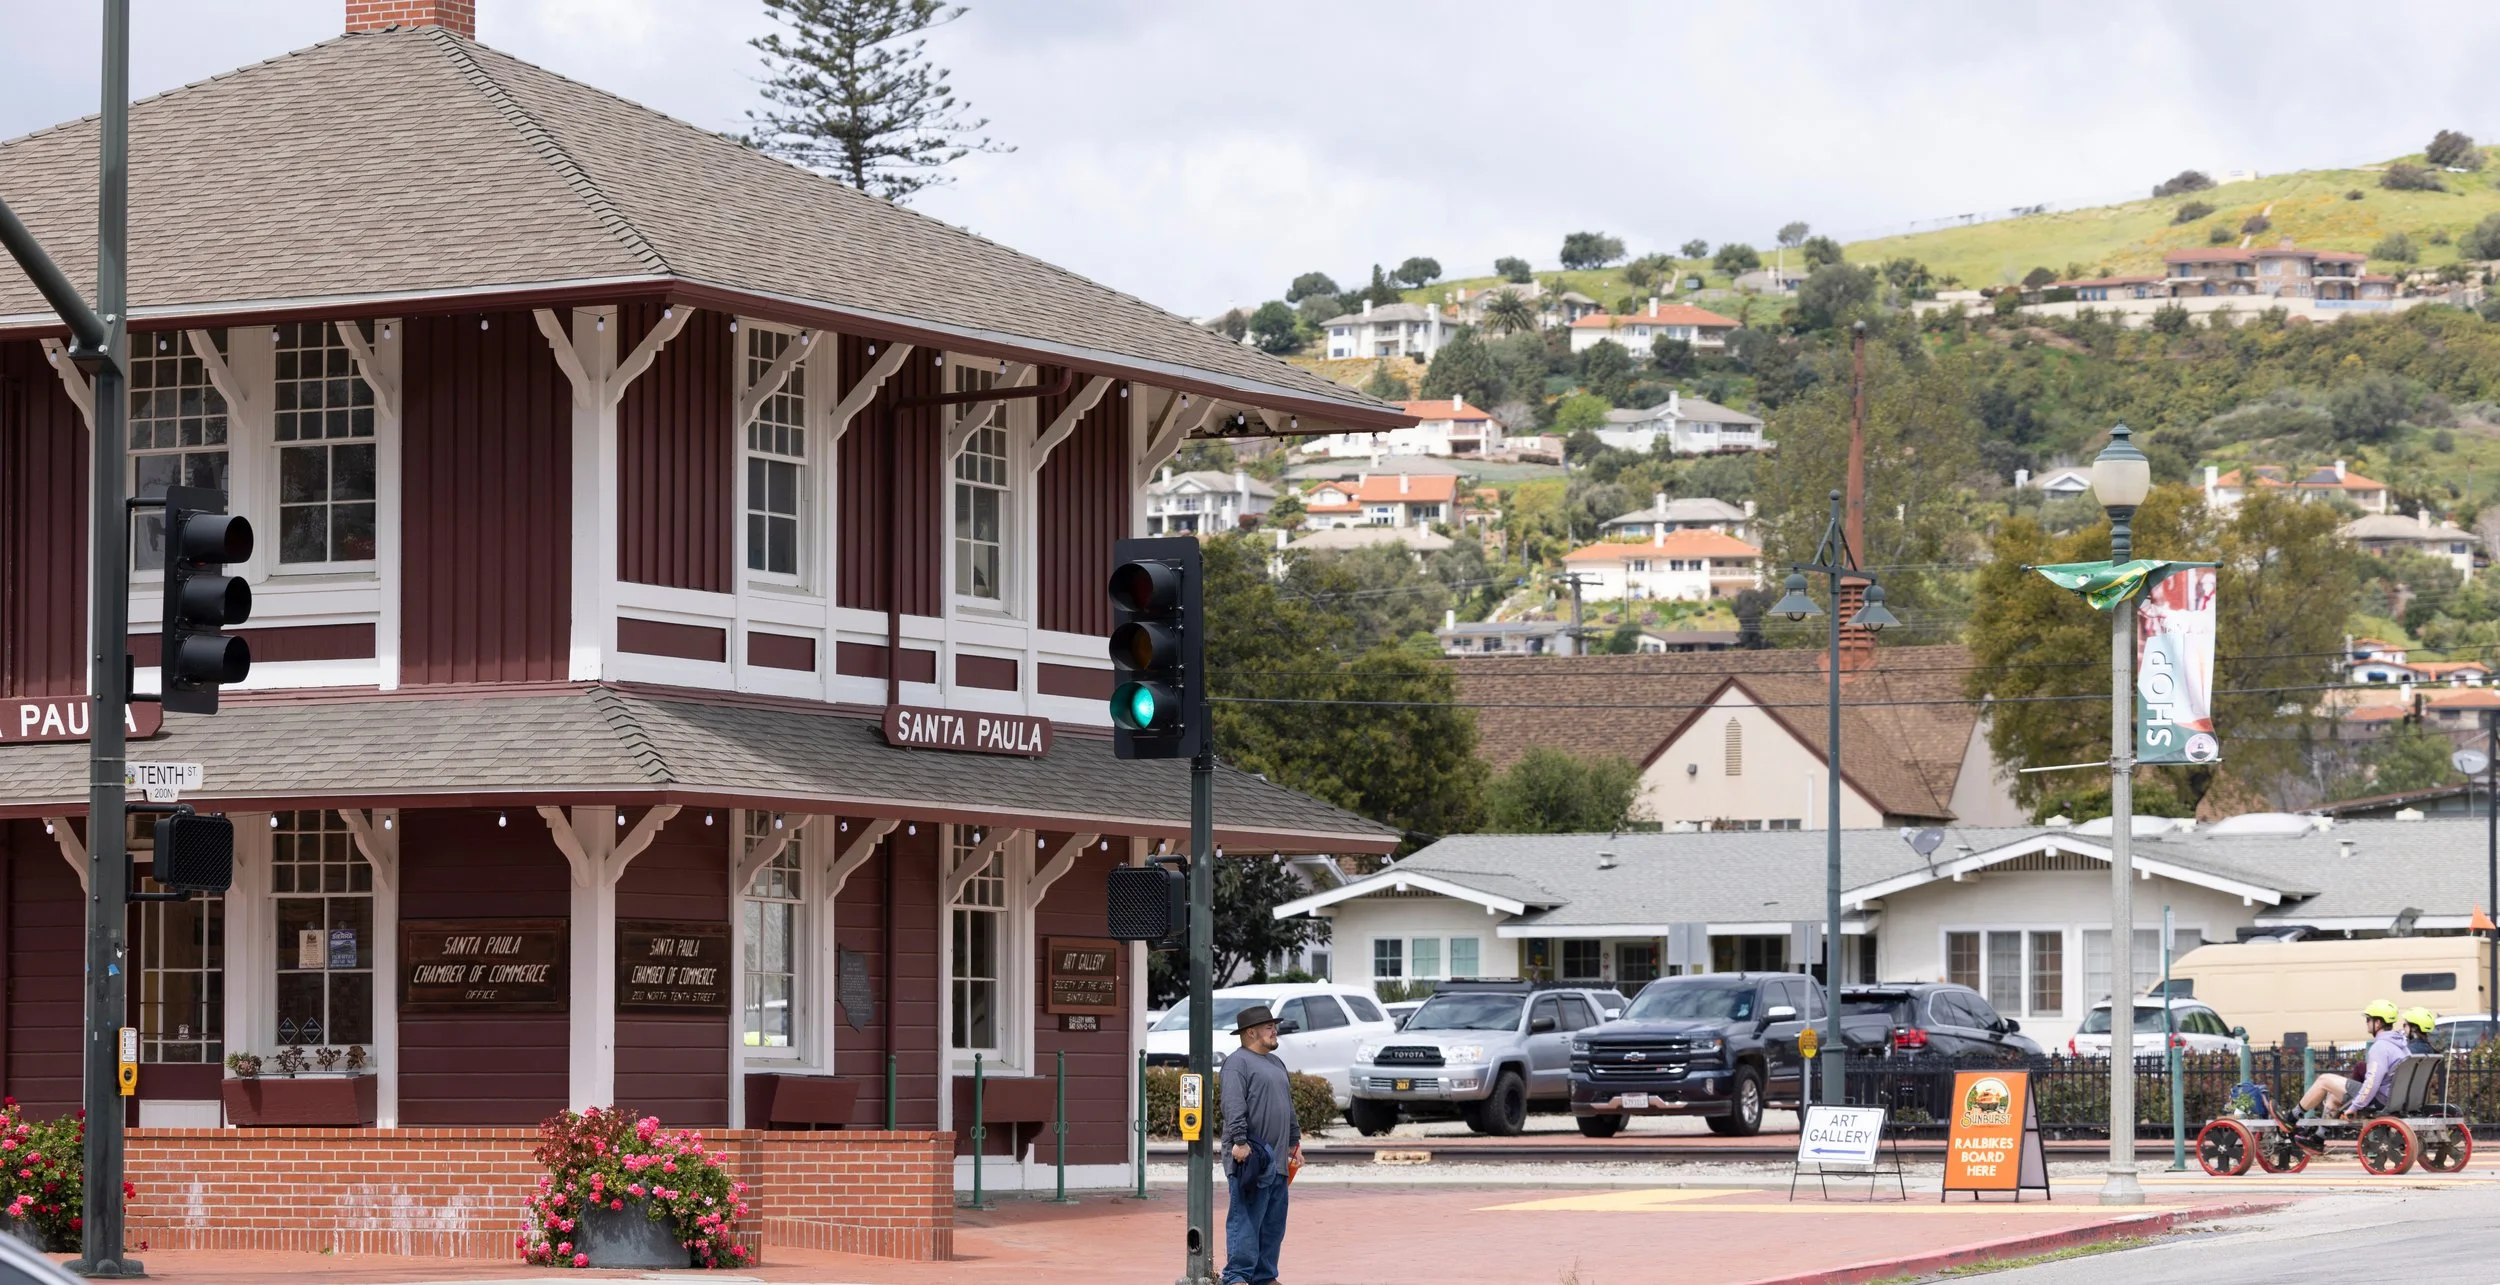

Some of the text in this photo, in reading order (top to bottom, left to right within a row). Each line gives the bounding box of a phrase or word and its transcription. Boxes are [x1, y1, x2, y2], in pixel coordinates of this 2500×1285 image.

[2146, 650, 2174, 747] SHOP
[20, 702, 137, 737] PAUA
[898, 711, 1042, 752] SANTA PAULA
[139, 765, 184, 785] TENTH
[442, 936, 523, 955] SANTA PAULA
[649, 938, 701, 957] SANTA PAULA
[1063, 952, 1106, 971] ART GALLERY
[413, 964, 551, 983] CHAMBER OF COMMERCE
[631, 965, 717, 986] CHAMBER OF COMMERCE
[1054, 980, 1114, 991] SOCIETY OF THE ARTS
[465, 990, 498, 1000] OFFICE
[632, 991, 717, 1002] 200 NORTH TENTH STREET
[1066, 993, 1102, 1003] SANTA PAULA
[1830, 1114, 1858, 1127] ART
[1809, 1129, 1872, 1144] GALLERY
[1954, 1137, 2014, 1150] RAILBIKES
[1961, 1151, 2005, 1163] BOARD
[1966, 1165, 1997, 1177] HERE
